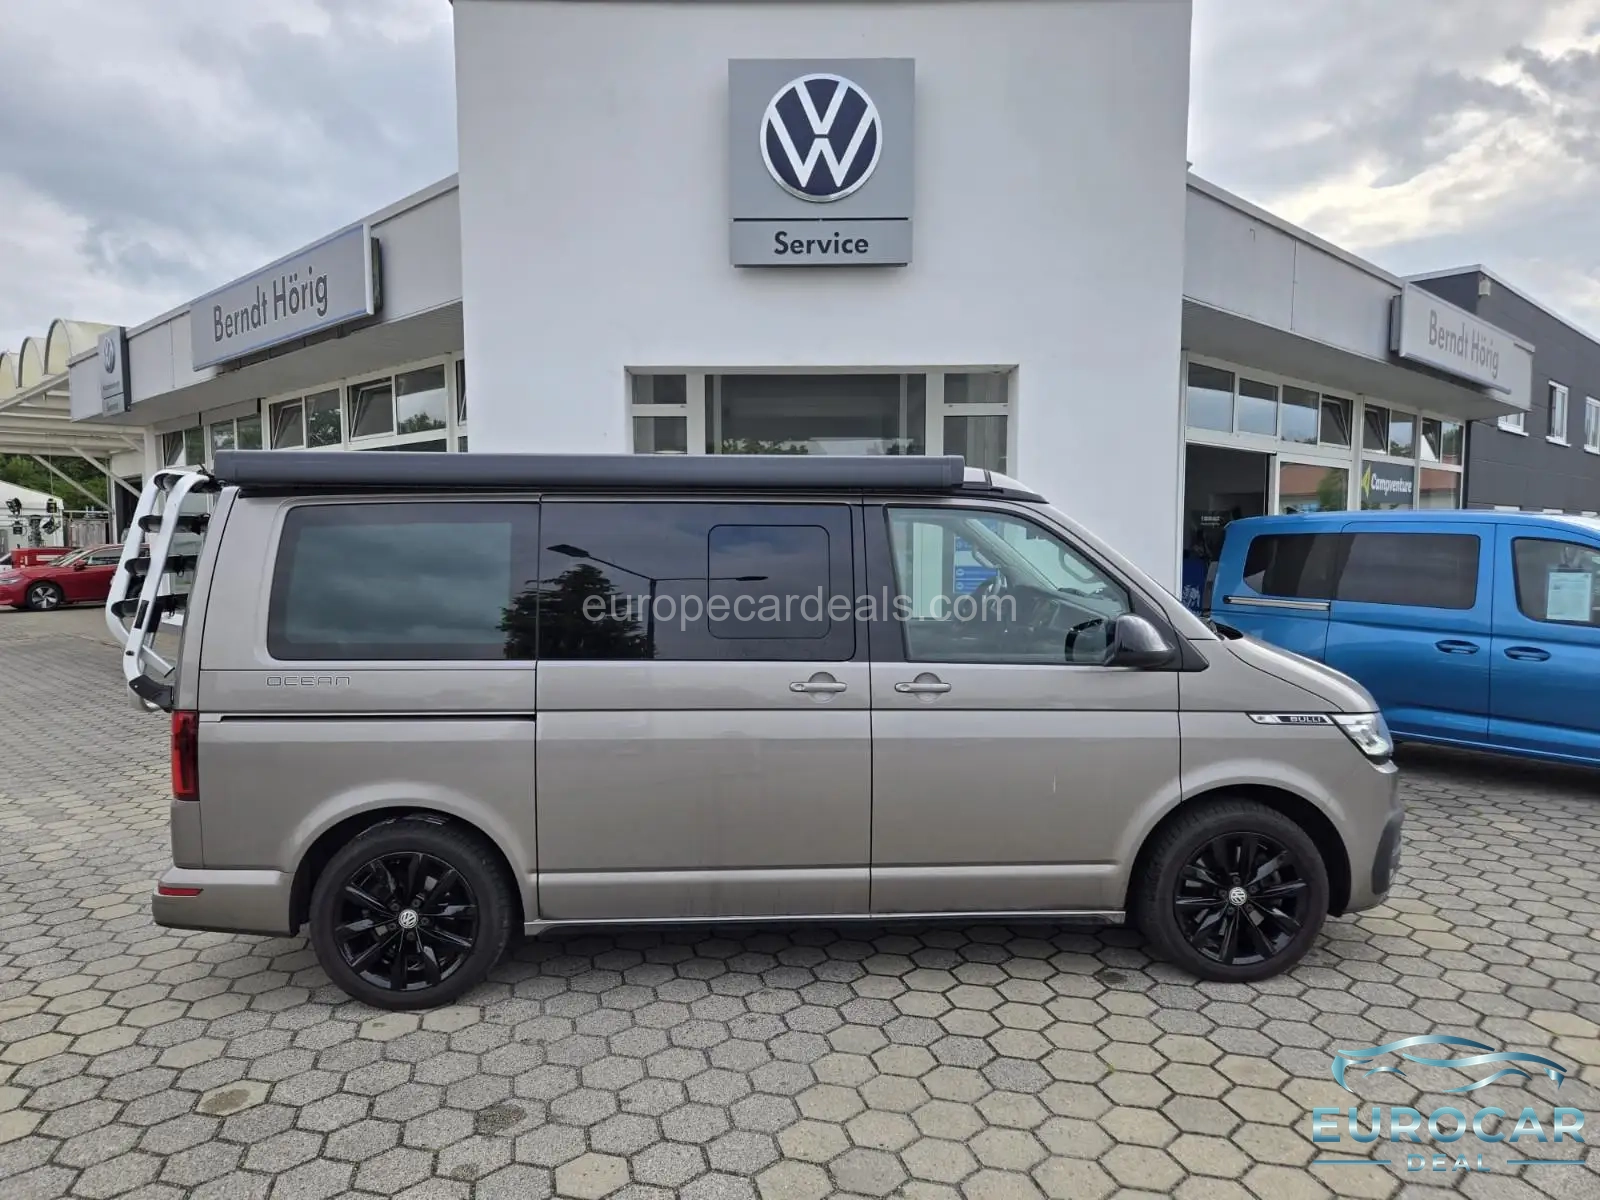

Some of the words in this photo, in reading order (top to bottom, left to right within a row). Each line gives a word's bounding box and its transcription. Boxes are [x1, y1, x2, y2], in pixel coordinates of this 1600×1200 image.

[774, 231, 869, 255] Service
[214, 285, 267, 342] Berndt
[273, 265, 328, 321] Hörig
[1429, 309, 1468, 360] Berndt
[1471, 328, 1499, 379] Hörig
[1371, 473, 1412, 496] Campventure
[266, 676, 350, 687] OCEAN
